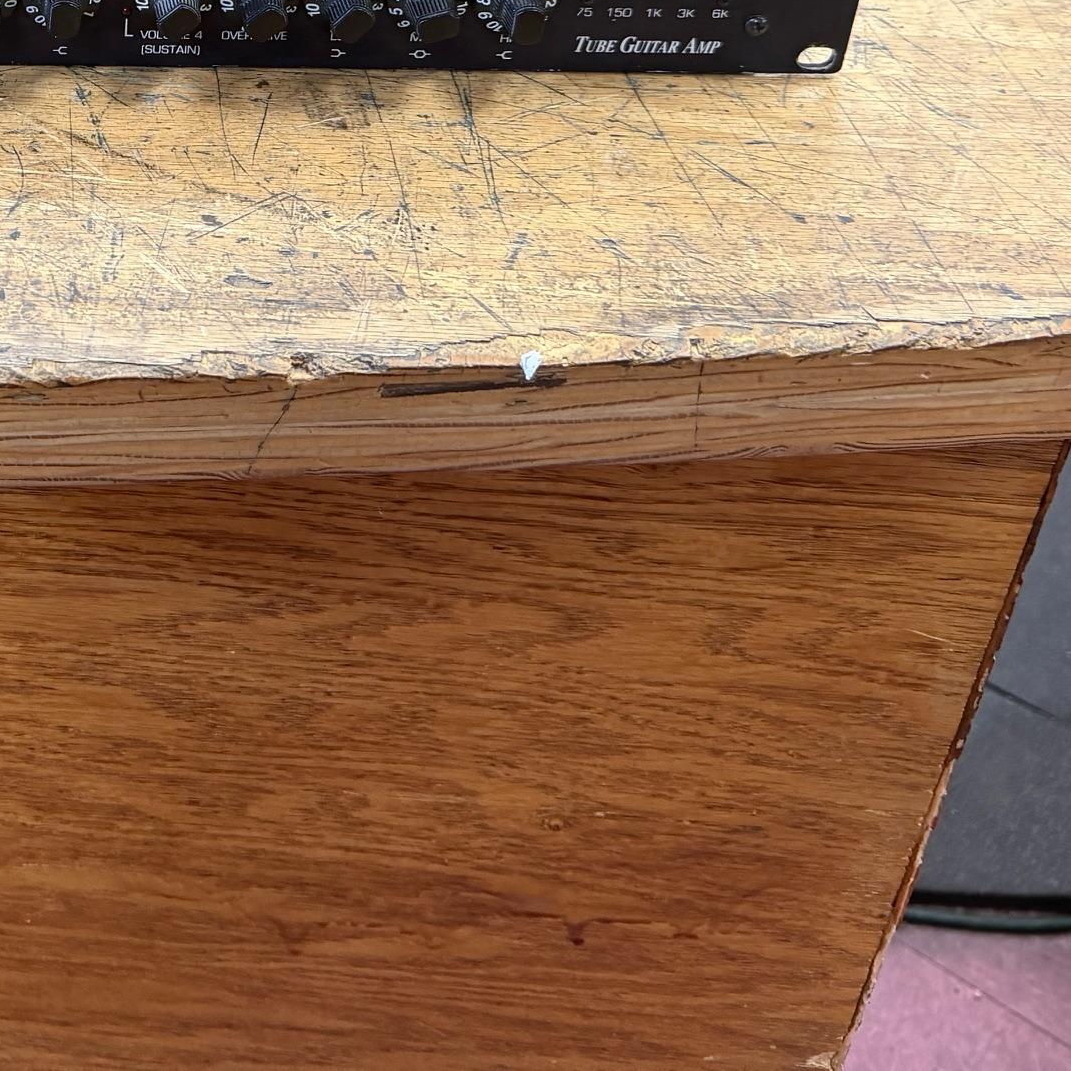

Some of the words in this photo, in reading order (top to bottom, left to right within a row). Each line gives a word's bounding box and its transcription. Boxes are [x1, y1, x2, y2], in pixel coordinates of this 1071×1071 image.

[606, 8, 632, 17] 150
[646, 9, 662, 17] 1K
[677, 9, 695, 17] 3K
[712, 9, 728, 18] 6K
[195, 31, 202, 39] 4
[574, 36, 617, 53] TUBE
[620, 36, 679, 53] GUITAR
[682, 38, 721, 54] AMP
[141, 45, 200, 56] (SUSTAIN)
